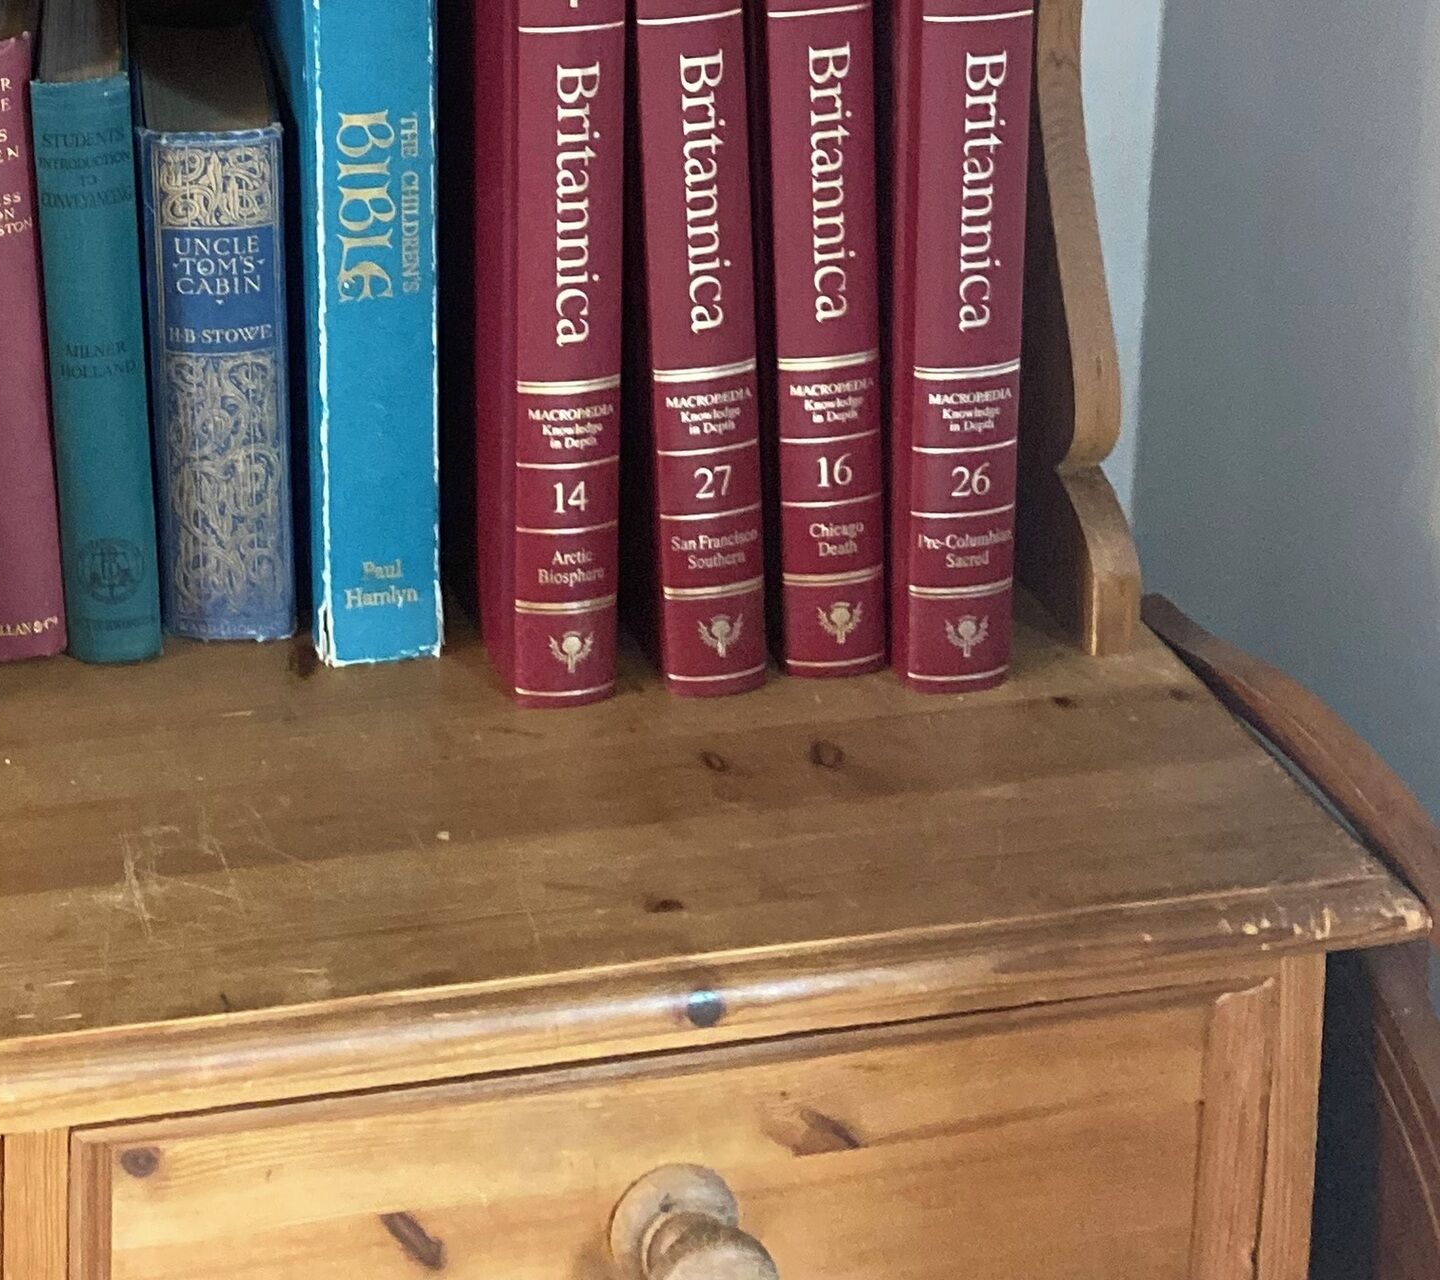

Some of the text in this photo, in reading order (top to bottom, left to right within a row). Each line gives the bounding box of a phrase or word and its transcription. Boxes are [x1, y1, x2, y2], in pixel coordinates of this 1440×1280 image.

[400, 112, 419, 159] THE
[679, 48, 731, 334] Britannica
[808, 41, 856, 323] Britannica
[958, 50, 1007, 332] Britannica
[336, 109, 396, 303] BIBLE
[556, 61, 600, 347] Britannica
[174, 235, 260, 256] UNCLE
[180, 255, 256, 276] TOM'S
[176, 274, 261, 295] CABIN
[804, 396, 864, 412] Knowledge
[942, 406, 1000, 420] Knowledge
[681, 406, 741, 424] Knowledge
[812, 410, 858, 424] in Depth
[542, 422, 603, 437] Knowledge
[689, 421, 735, 435] in Depth
[950, 419, 994, 433] in Depth
[550, 436, 598, 450] in Depth
[817, 453, 853, 488] 16
[951, 462, 991, 497] 26
[694, 465, 732, 499] 27
[553, 481, 589, 514] 14
[671, 529, 758, 551] San Francisco
[810, 521, 864, 539] Chicago
[918, 528, 1013, 550] Pre-Columbian
[552, 549, 592, 566] Arctic
[818, 540, 858, 557] Death
[362, 558, 403, 580] Paul
[688, 551, 745, 570] Southern
[945, 550, 989, 569] Sacred
[538, 567, 604, 587] Biosphere
[344, 584, 418, 610] Hamlyn
